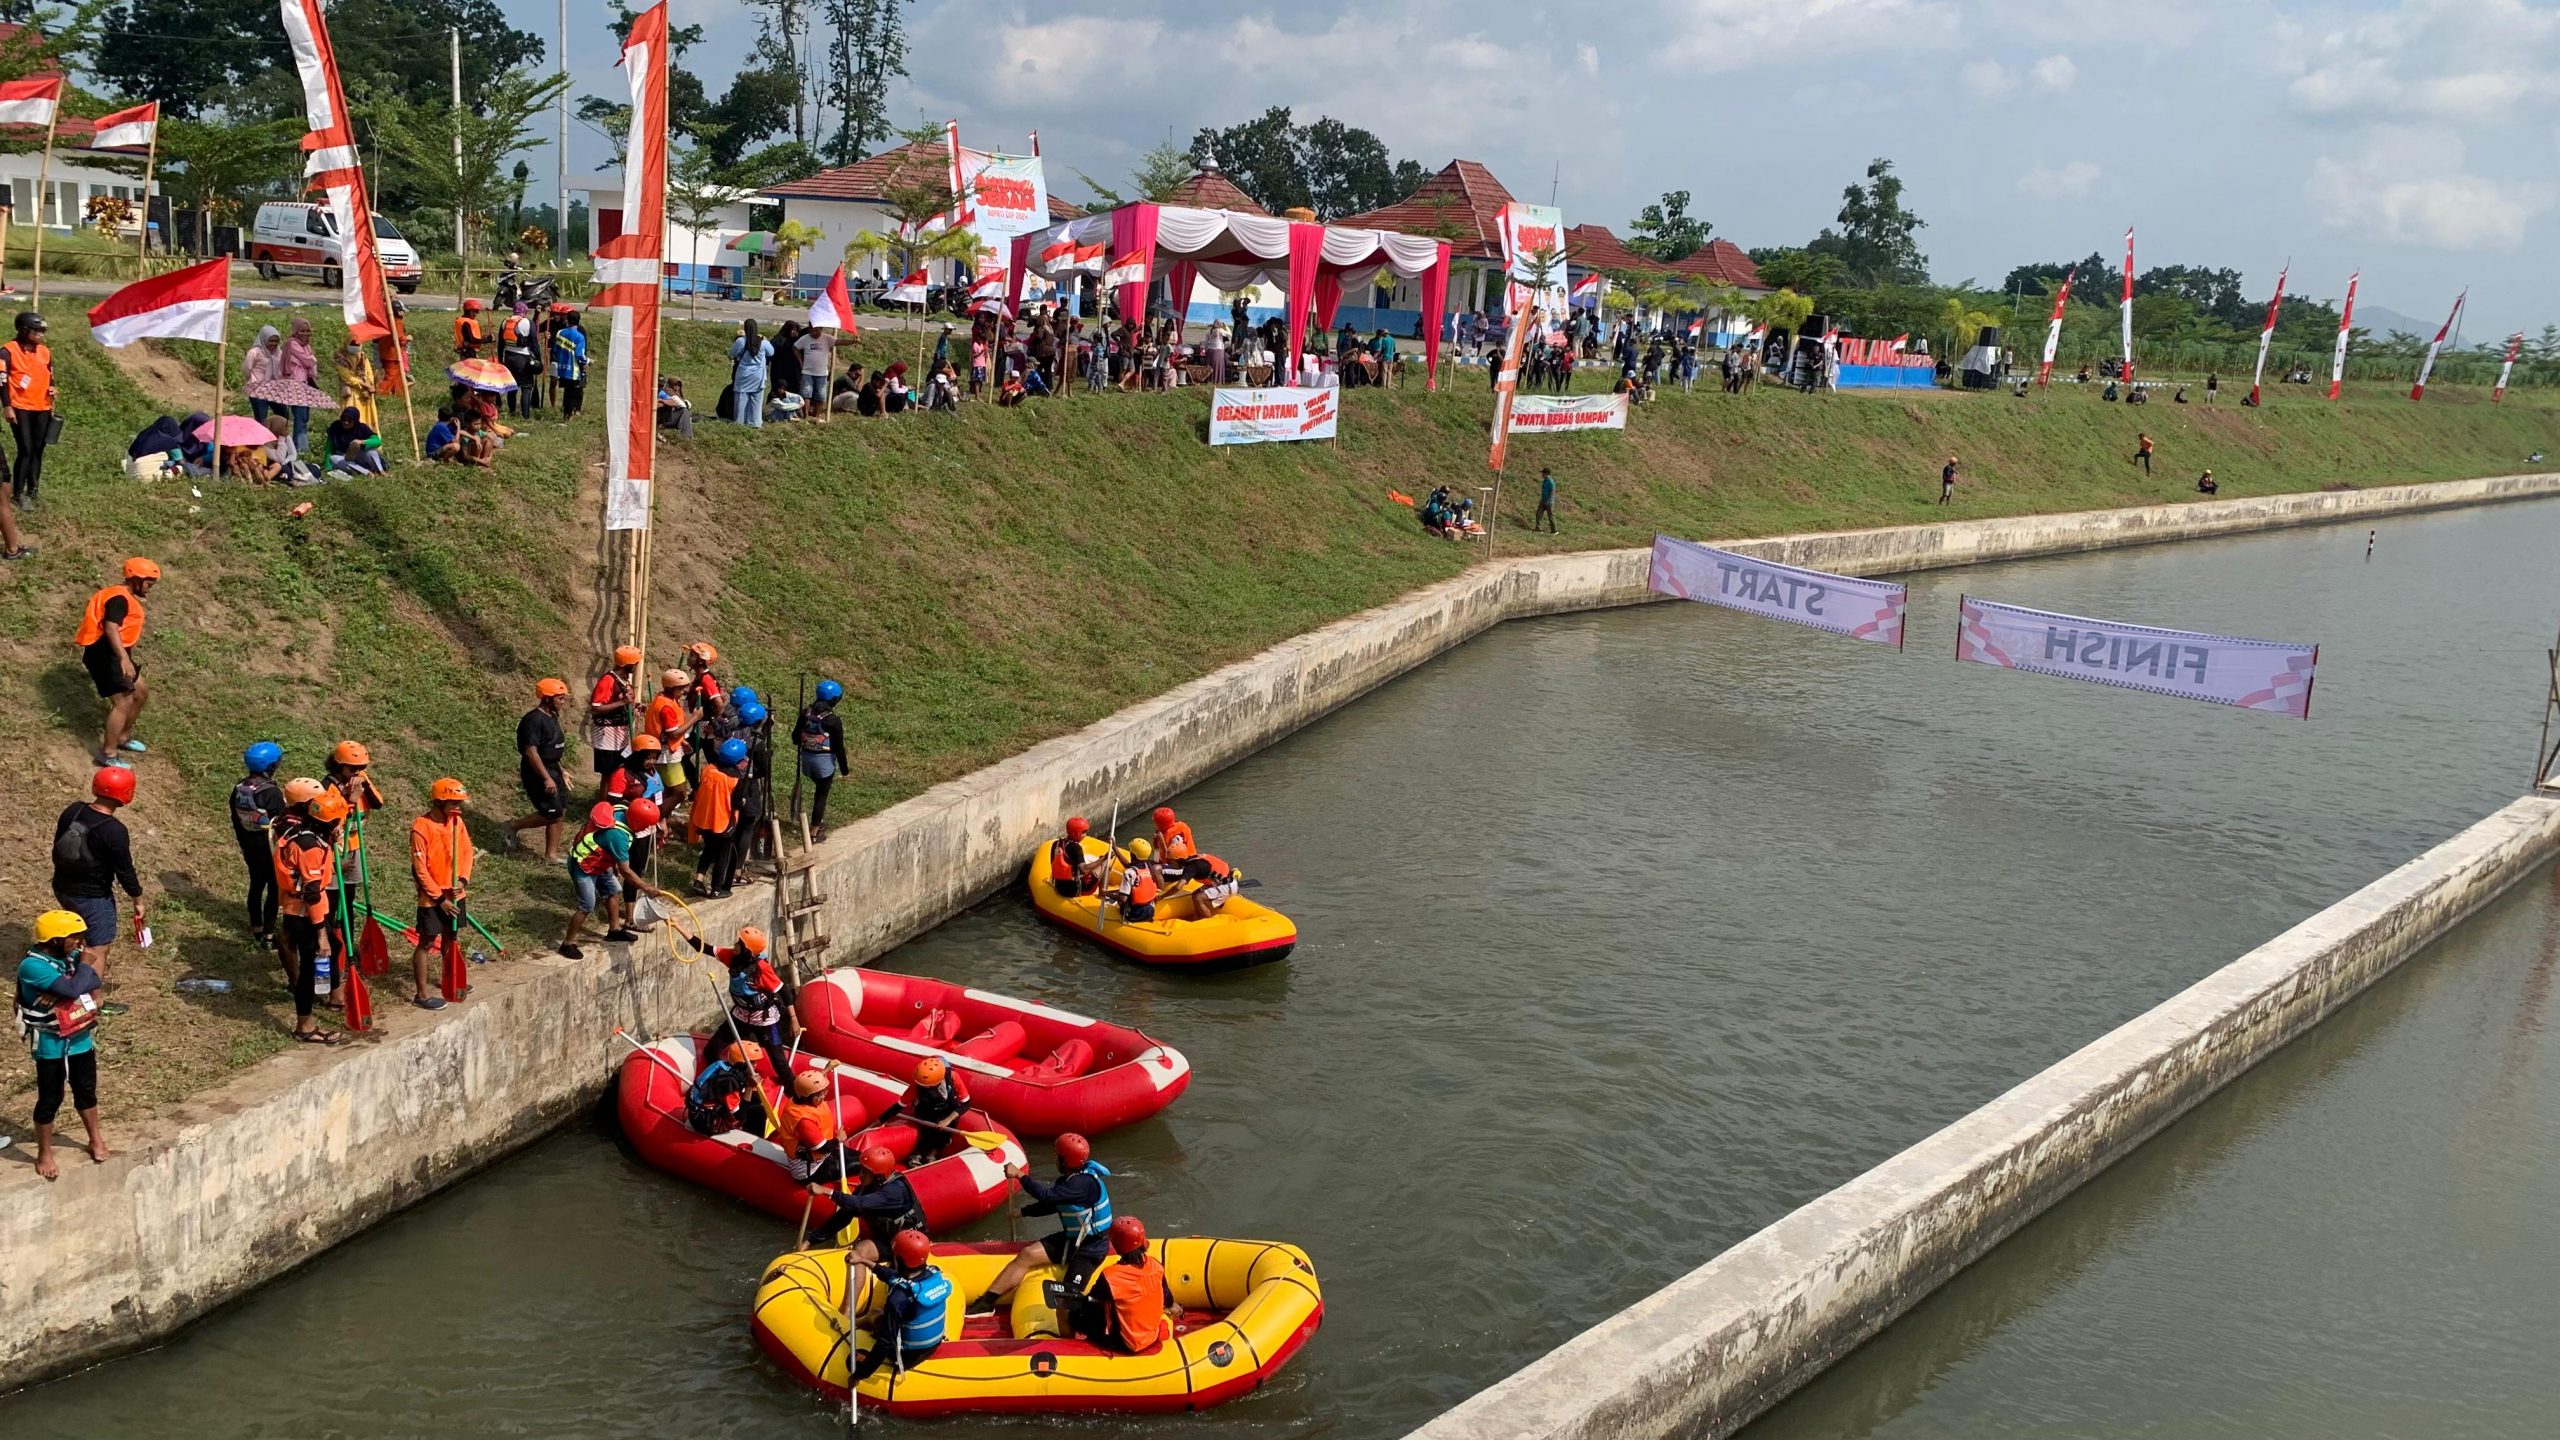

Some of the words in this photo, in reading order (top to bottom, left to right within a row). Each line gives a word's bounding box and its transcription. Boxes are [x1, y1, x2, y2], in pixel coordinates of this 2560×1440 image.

[1216, 405, 1261, 422] SELAMAT
[1262, 403, 1299, 420] DATANG
[1546, 412, 1574, 426] BEBAS
